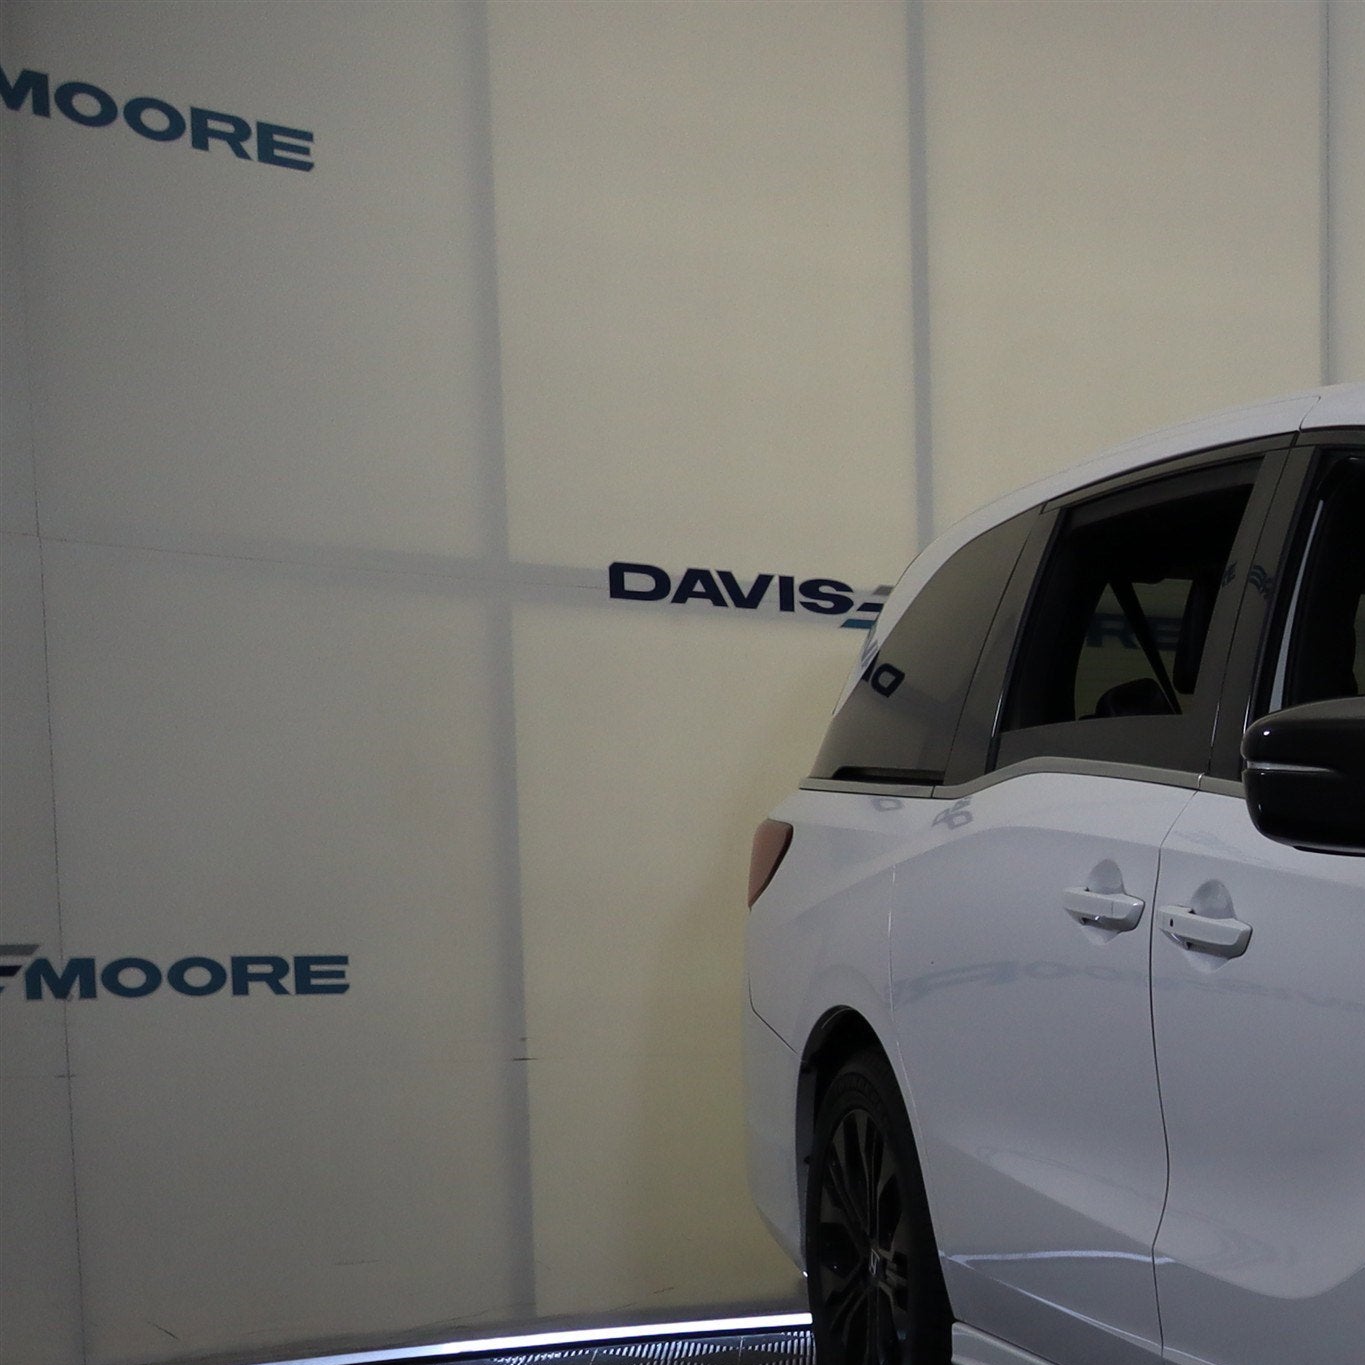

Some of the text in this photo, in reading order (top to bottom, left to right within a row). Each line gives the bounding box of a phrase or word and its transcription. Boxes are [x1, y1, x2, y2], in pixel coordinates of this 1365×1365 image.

[0, 67, 315, 172] MOORE
[608, 561, 854, 615] DAVIS
[24, 955, 350, 1001] MOORE
